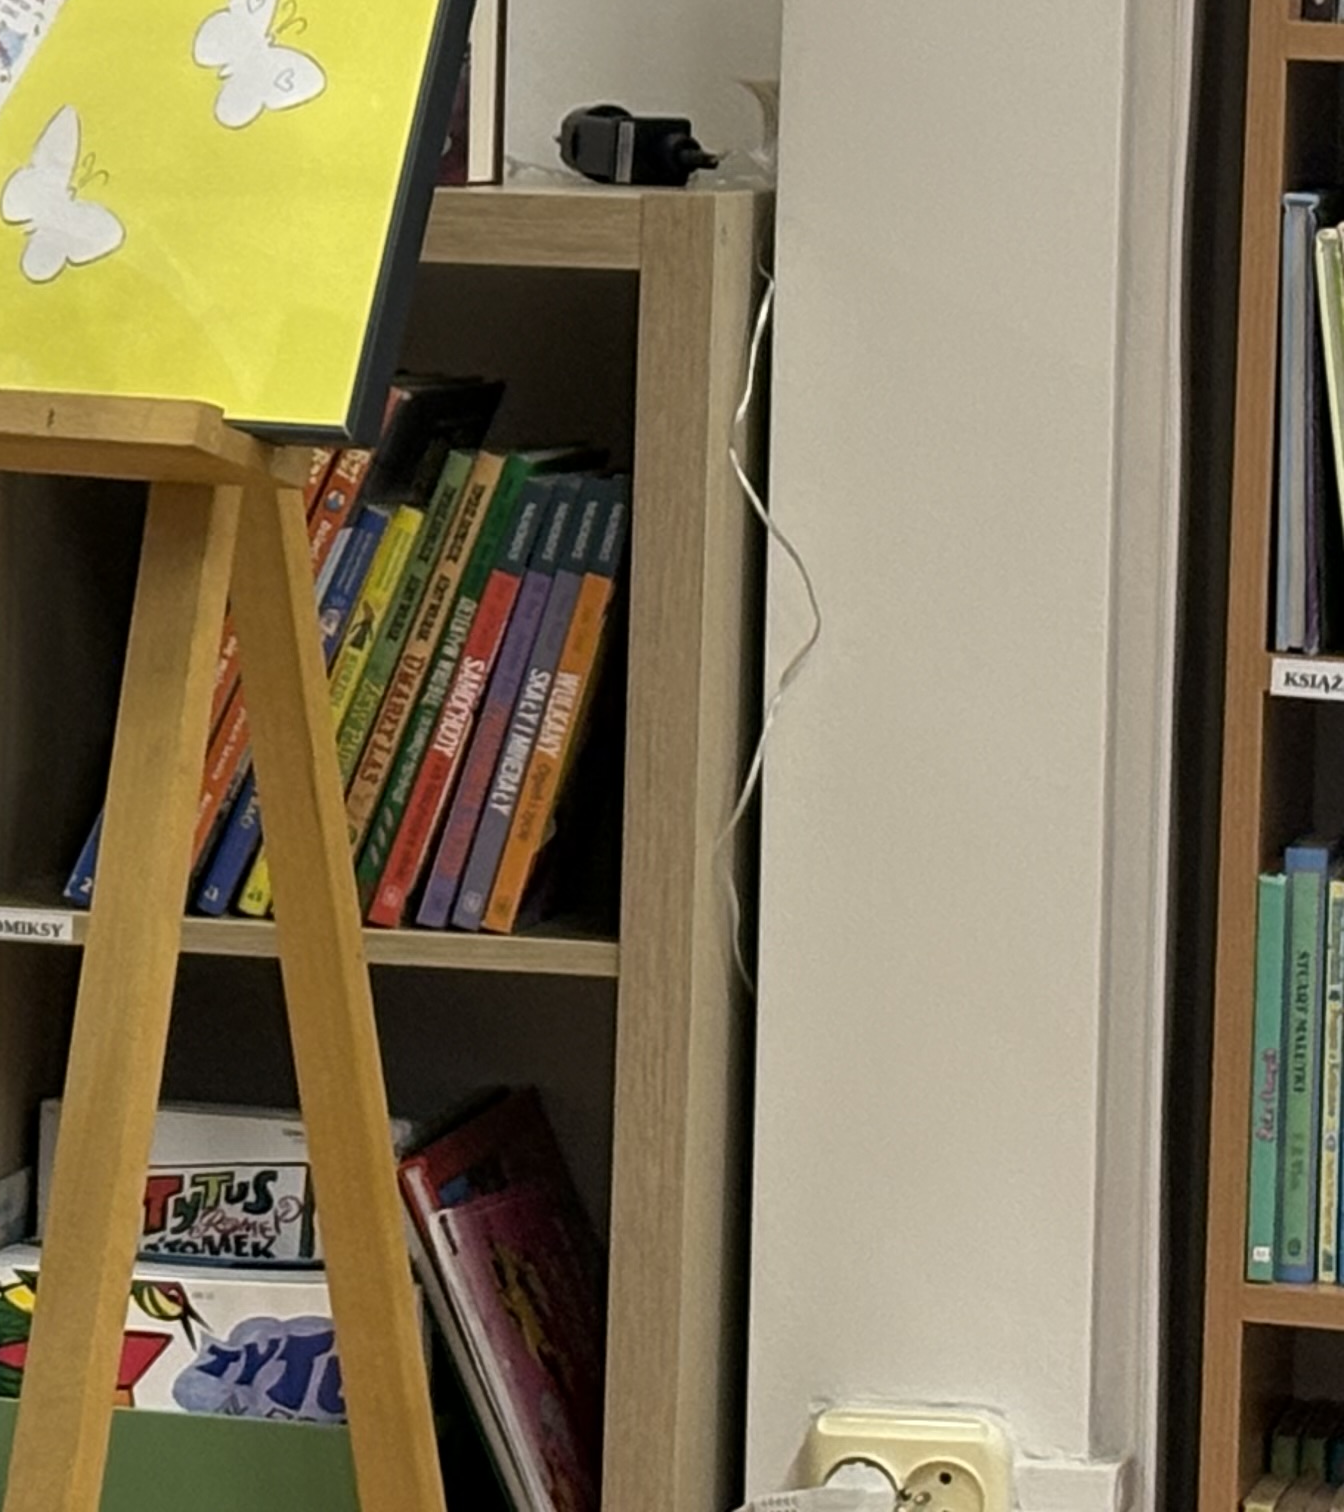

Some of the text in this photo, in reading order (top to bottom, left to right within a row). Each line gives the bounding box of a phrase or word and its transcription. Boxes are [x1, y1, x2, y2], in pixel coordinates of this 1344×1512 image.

[432, 656, 488, 759] SAMOCHODY
[536, 670, 584, 758] WULKANY
[1283, 669, 1344, 692] KSIĄŻ
[490, 668, 554, 816] SKAŁY MINERAŁY
[143, 1170, 278, 1236] TYTUS
